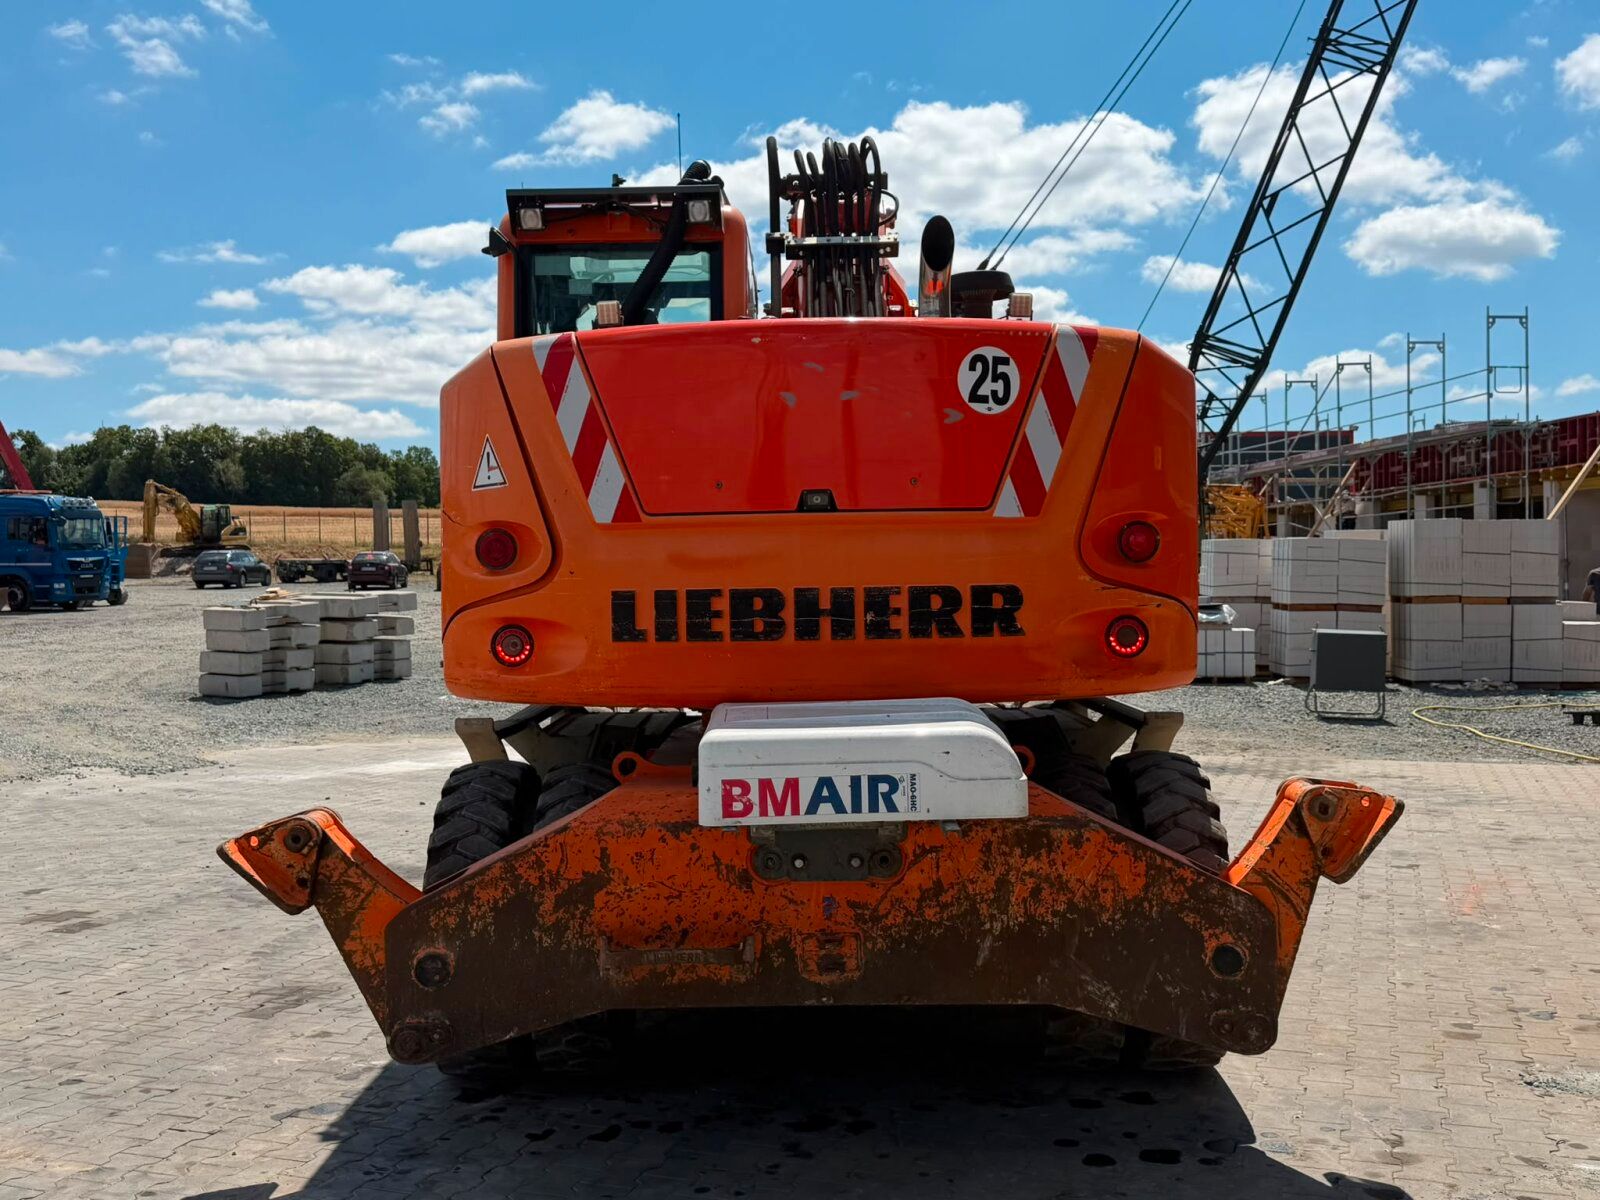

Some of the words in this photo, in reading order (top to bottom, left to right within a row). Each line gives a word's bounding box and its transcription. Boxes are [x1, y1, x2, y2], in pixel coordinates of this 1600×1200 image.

[968, 353, 1011, 406] 25
[611, 584, 1026, 642] LIEBHERR
[721, 774, 900, 819] BMAIR
